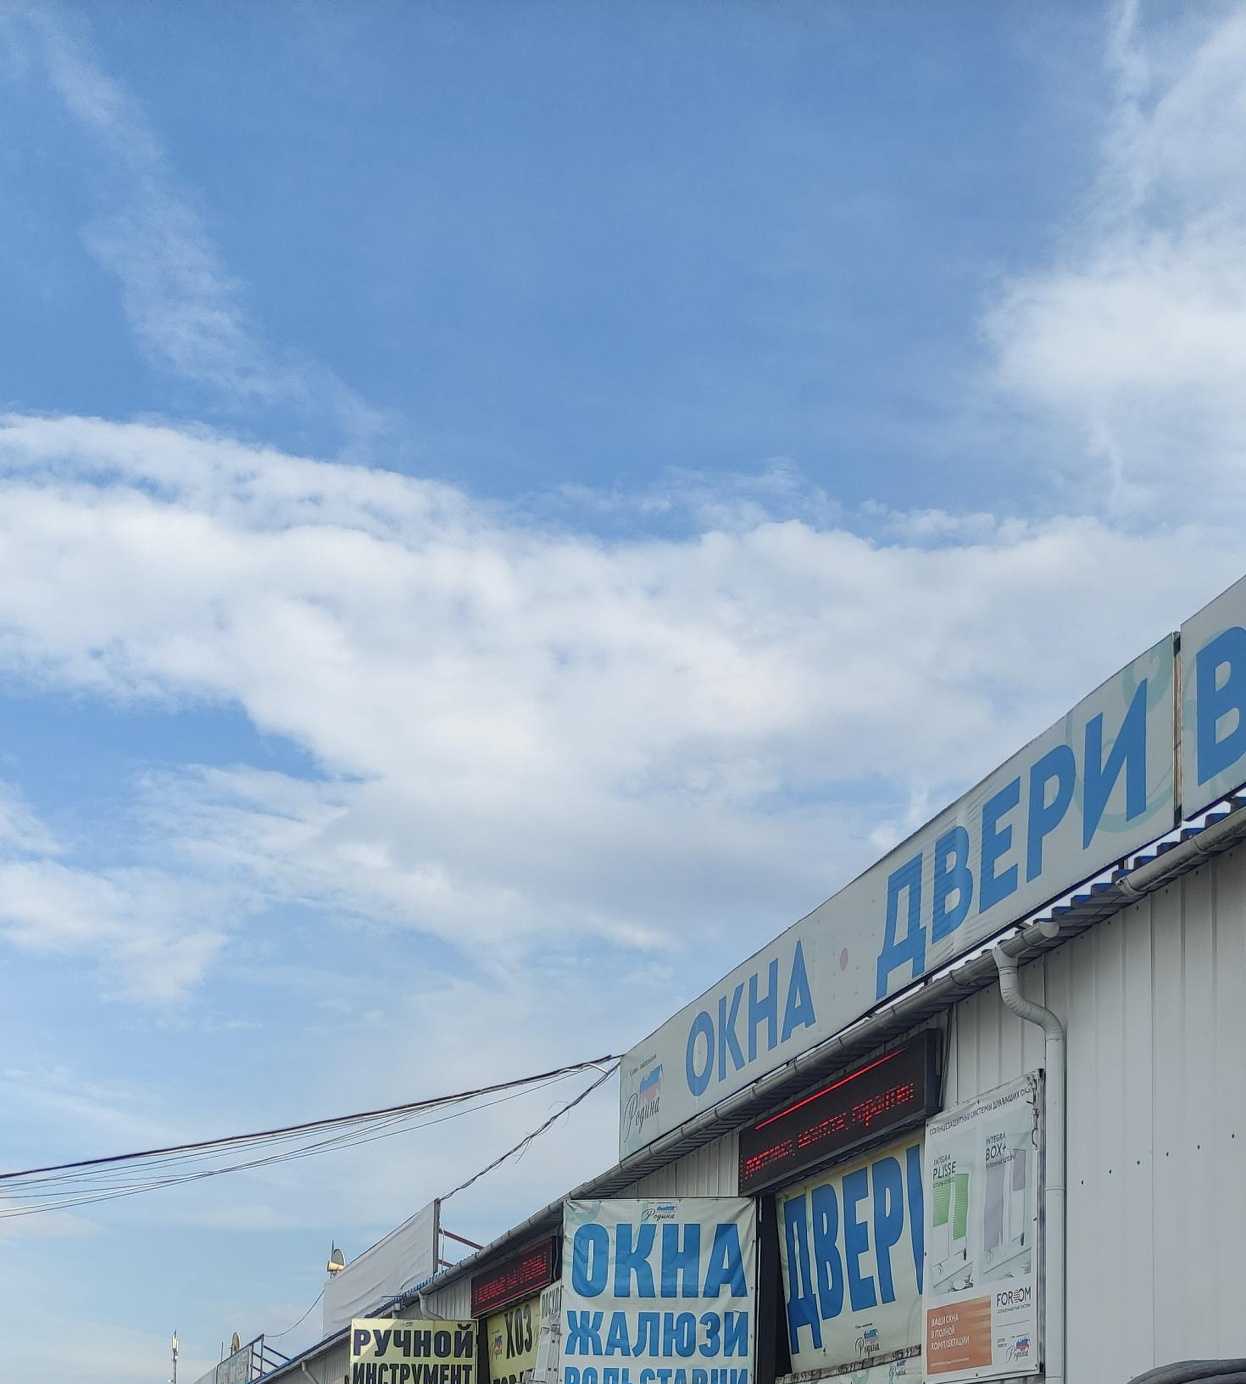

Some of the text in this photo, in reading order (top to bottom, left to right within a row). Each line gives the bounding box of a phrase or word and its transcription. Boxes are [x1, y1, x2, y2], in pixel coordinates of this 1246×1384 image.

[686, 939, 816, 1097] ОКНА
[875, 677, 1148, 1002] ДВЕРИ
[933, 1161, 957, 1180] PLISSE
[985, 1143, 1007, 1161] BOX+
[571, 1223, 749, 1298] ОКНА
[353, 1323, 474, 1359] РУЧНОЙ
[504, 1304, 533, 1360] ХОЗ
[564, 1311, 749, 1358] ЖАЛЮЗИ
